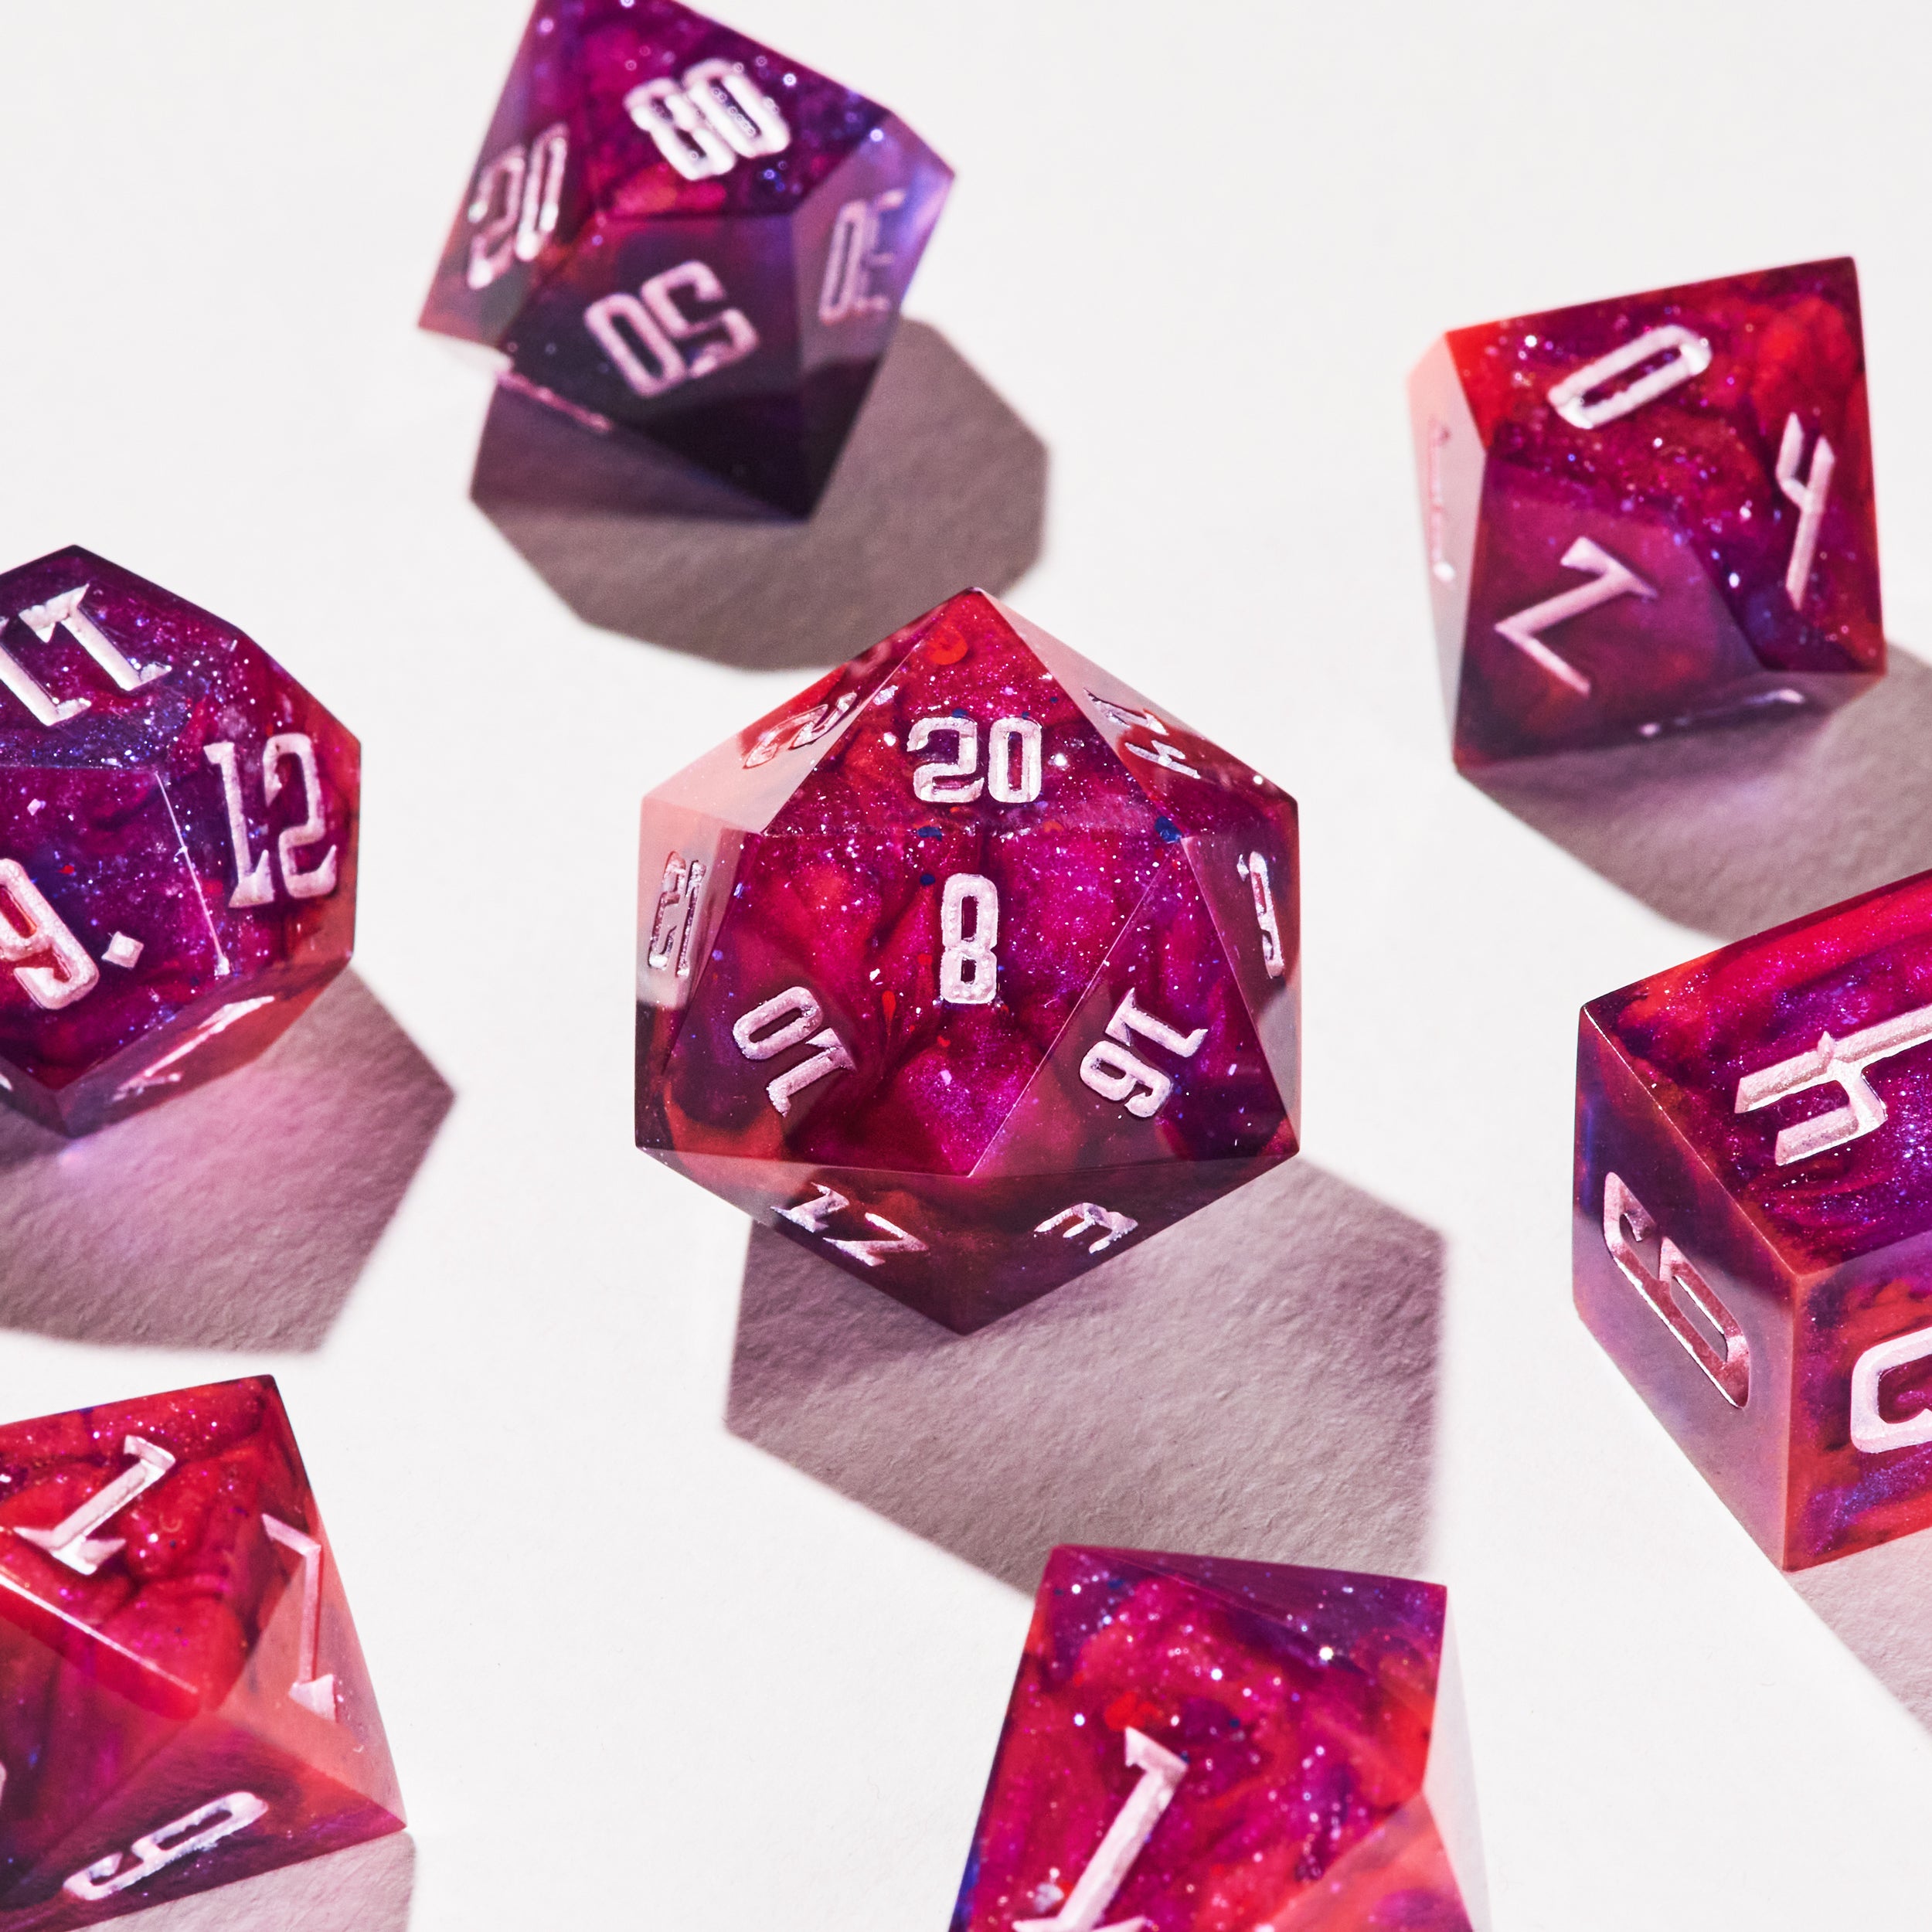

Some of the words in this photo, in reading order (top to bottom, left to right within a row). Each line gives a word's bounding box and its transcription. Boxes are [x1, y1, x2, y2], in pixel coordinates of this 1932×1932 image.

[623, 58, 791, 181] 80
[1776, 412, 1835, 612] 4
[203, 733, 337, 907] 12
[906, 714, 1042, 804] 20
[939, 872, 999, 1005] 8
[732, 985, 857, 1117] 10
[1078, 987, 1209, 1118] 16
[13, 1434, 177, 1577] 1
[1012, 1726, 1189, 1932] 1
